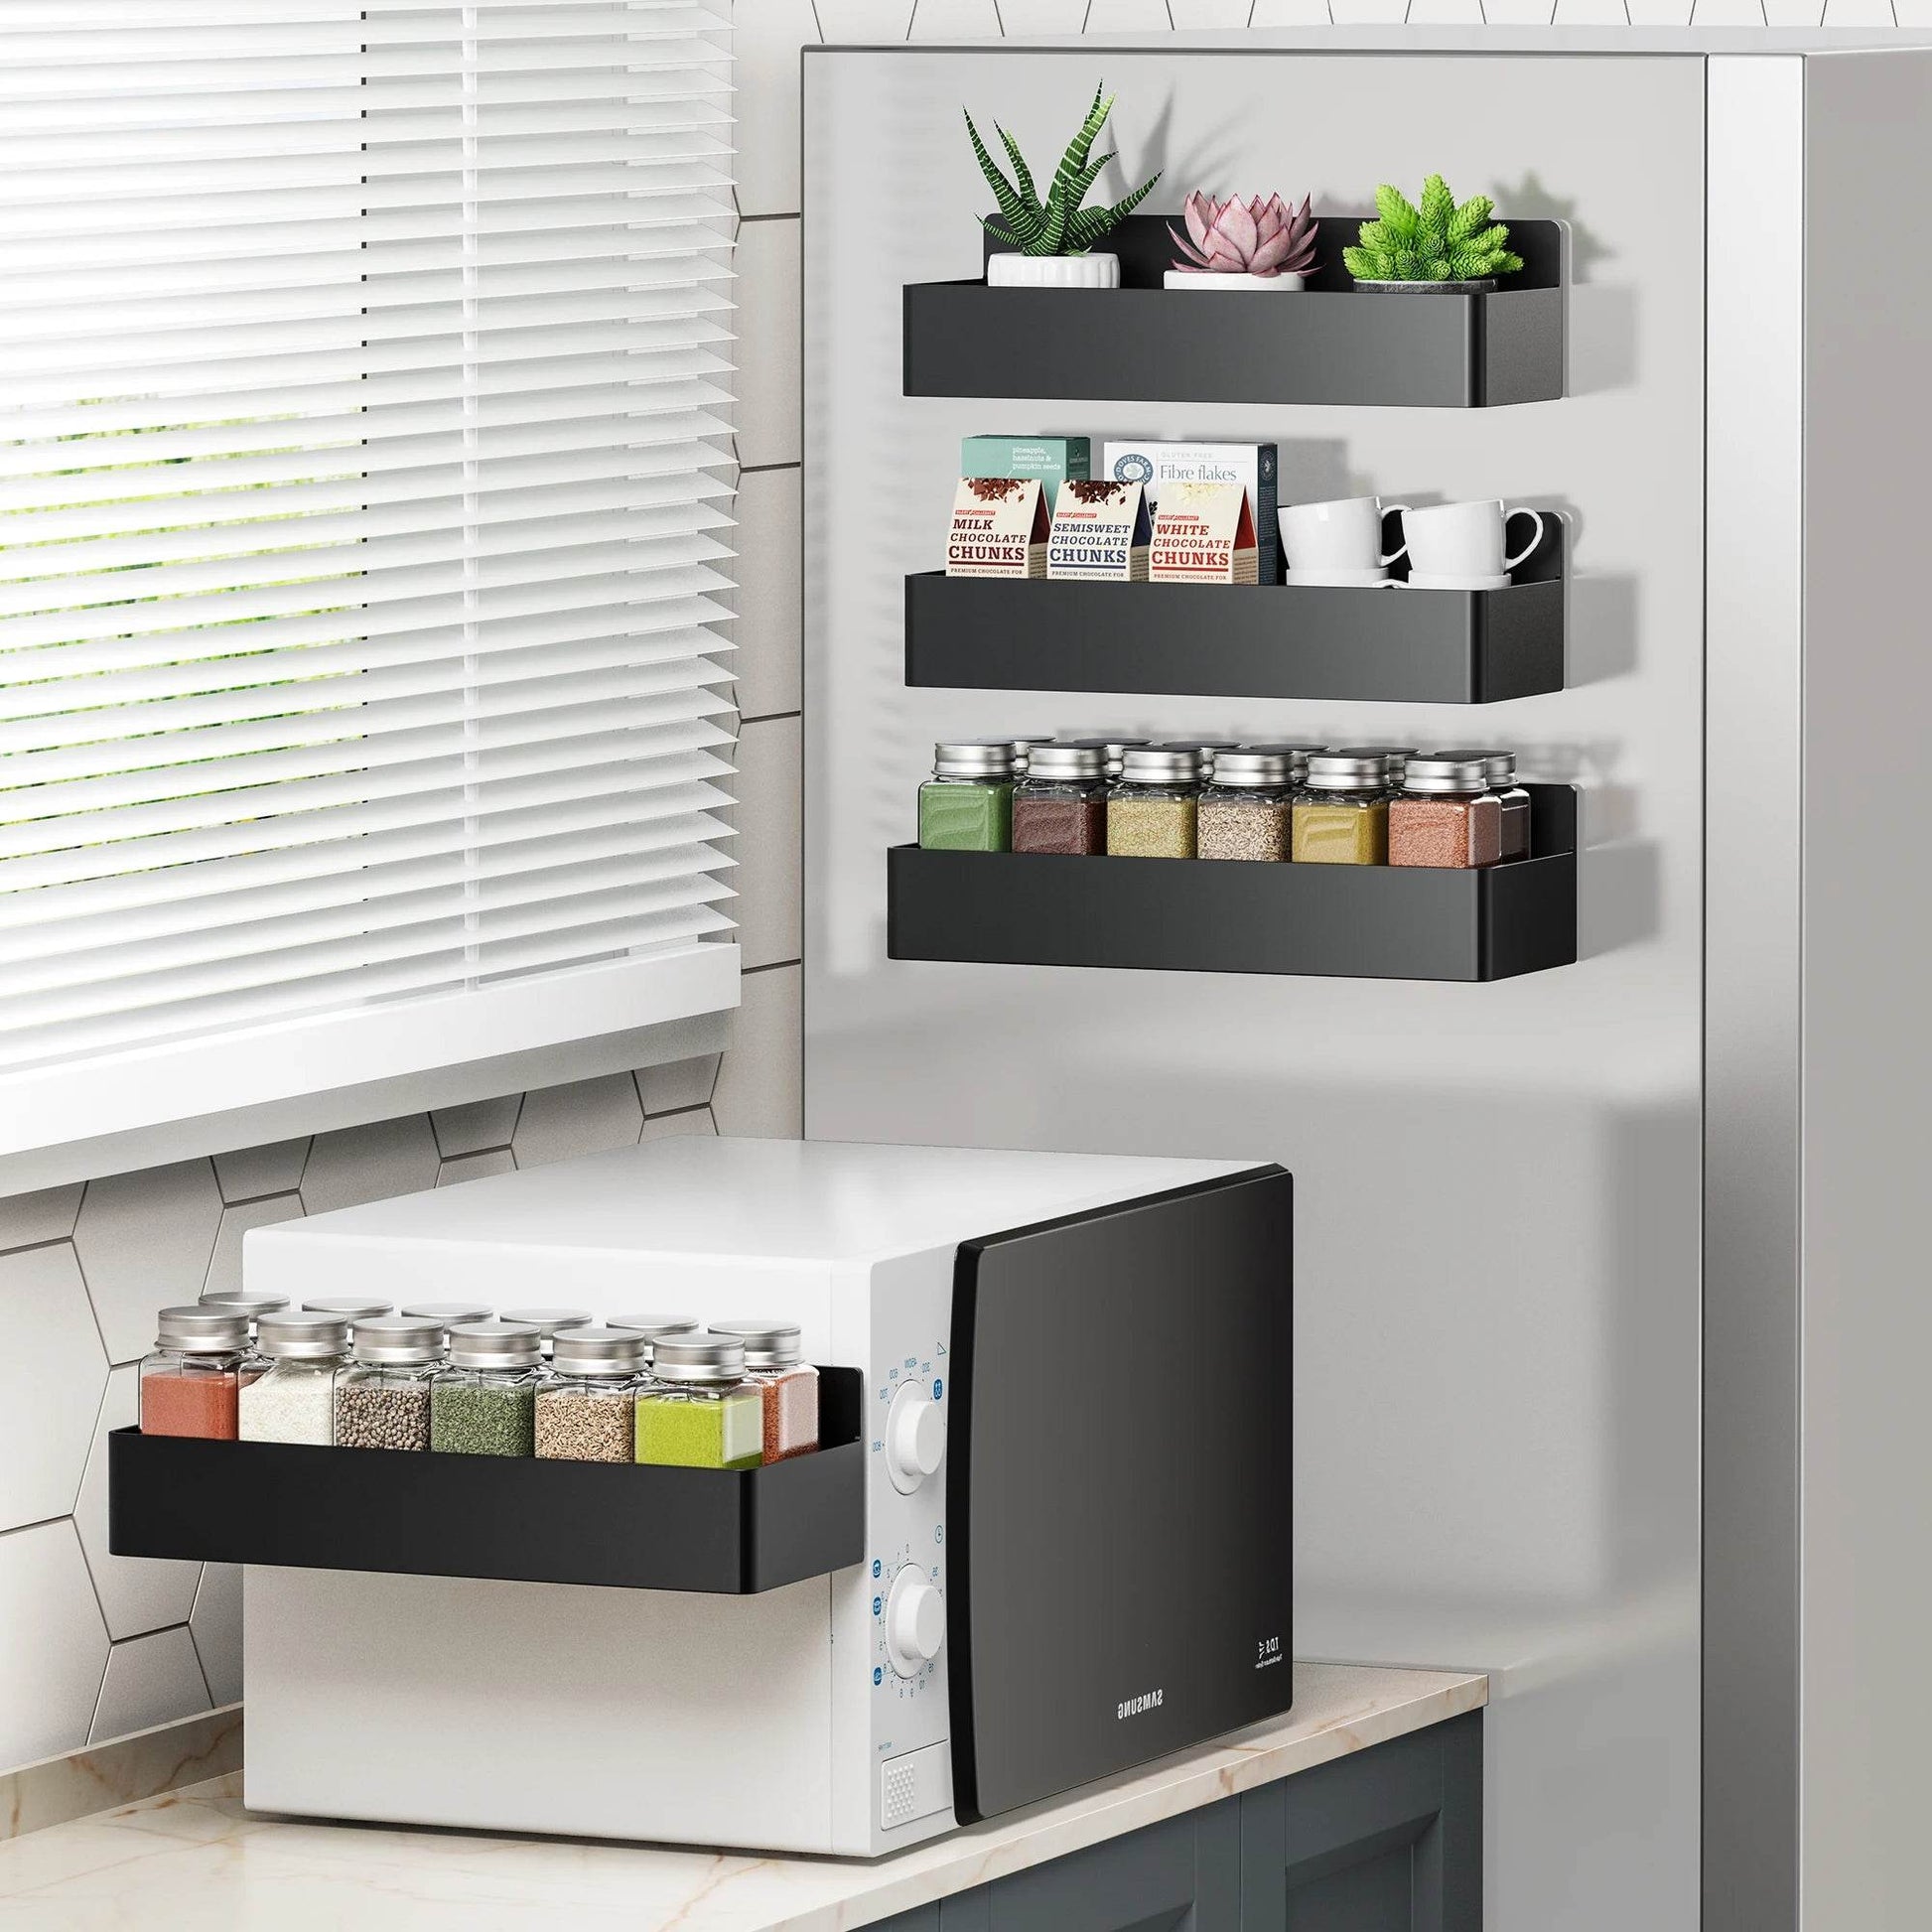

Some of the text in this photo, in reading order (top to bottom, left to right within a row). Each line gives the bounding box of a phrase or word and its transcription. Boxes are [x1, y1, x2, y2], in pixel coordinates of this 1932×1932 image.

[1160, 464, 1194, 480] Fibre
[1198, 465, 1237, 481] flakes
[953, 518, 994, 530] MILK
[1053, 522, 1131, 534] SEMISWEET
[1156, 523, 1210, 536] WHITE
[950, 533, 1027, 544] CHOCOLATE
[1051, 535, 1129, 546] CHOCOLATE
[1153, 538, 1231, 549] CHOCOLATE
[948, 545, 1025, 561] CHUNKS
[1049, 548, 1127, 564] CHUNKS
[1151, 550, 1229, 566] CHUNKS
